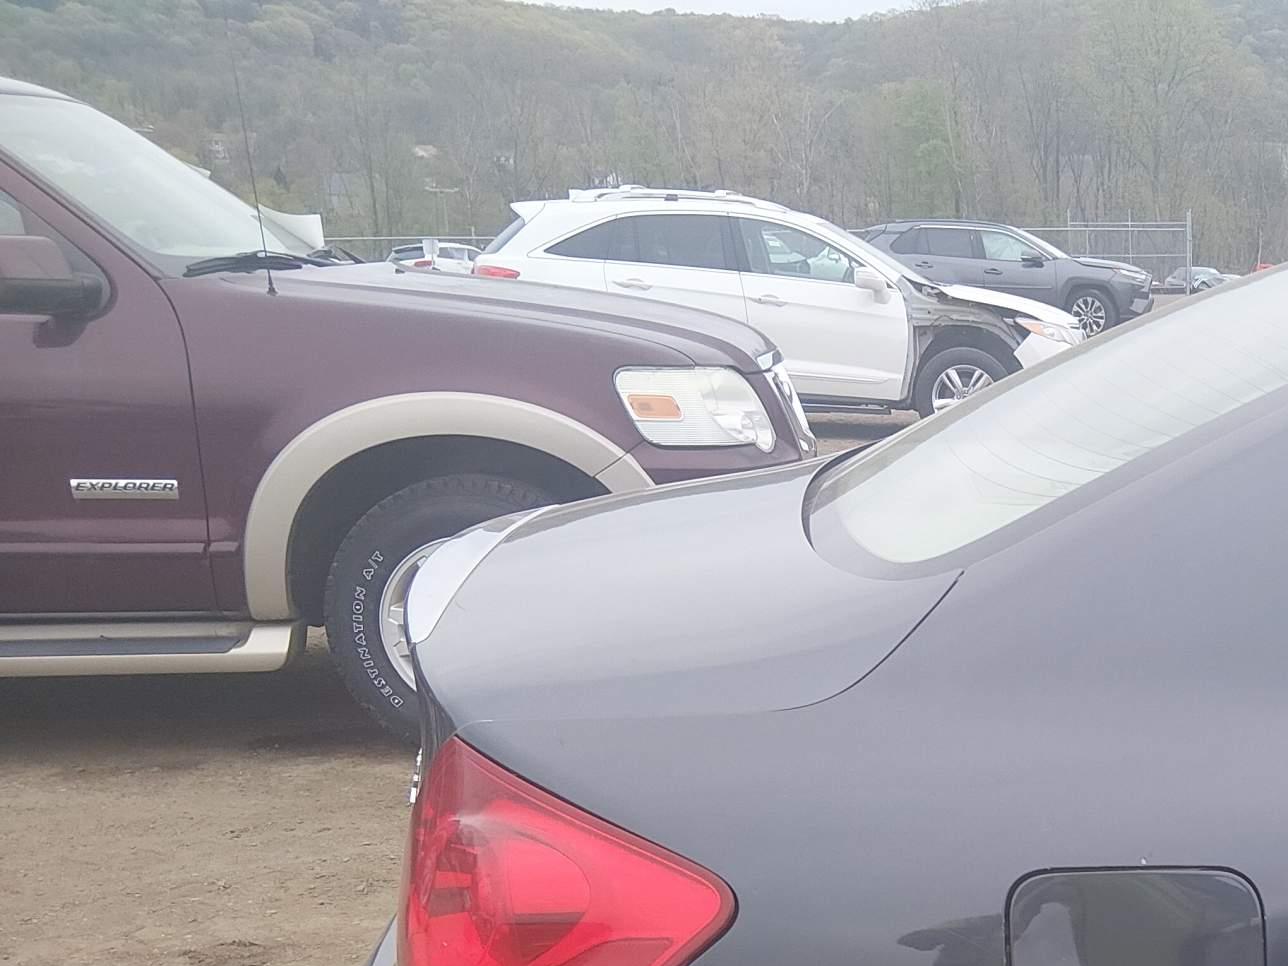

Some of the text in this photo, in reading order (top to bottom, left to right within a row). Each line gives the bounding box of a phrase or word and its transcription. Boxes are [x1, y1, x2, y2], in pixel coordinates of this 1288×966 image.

[75, 481, 176, 492] EXPLORER
[352, 551, 404, 708] DESTINATION A/T
